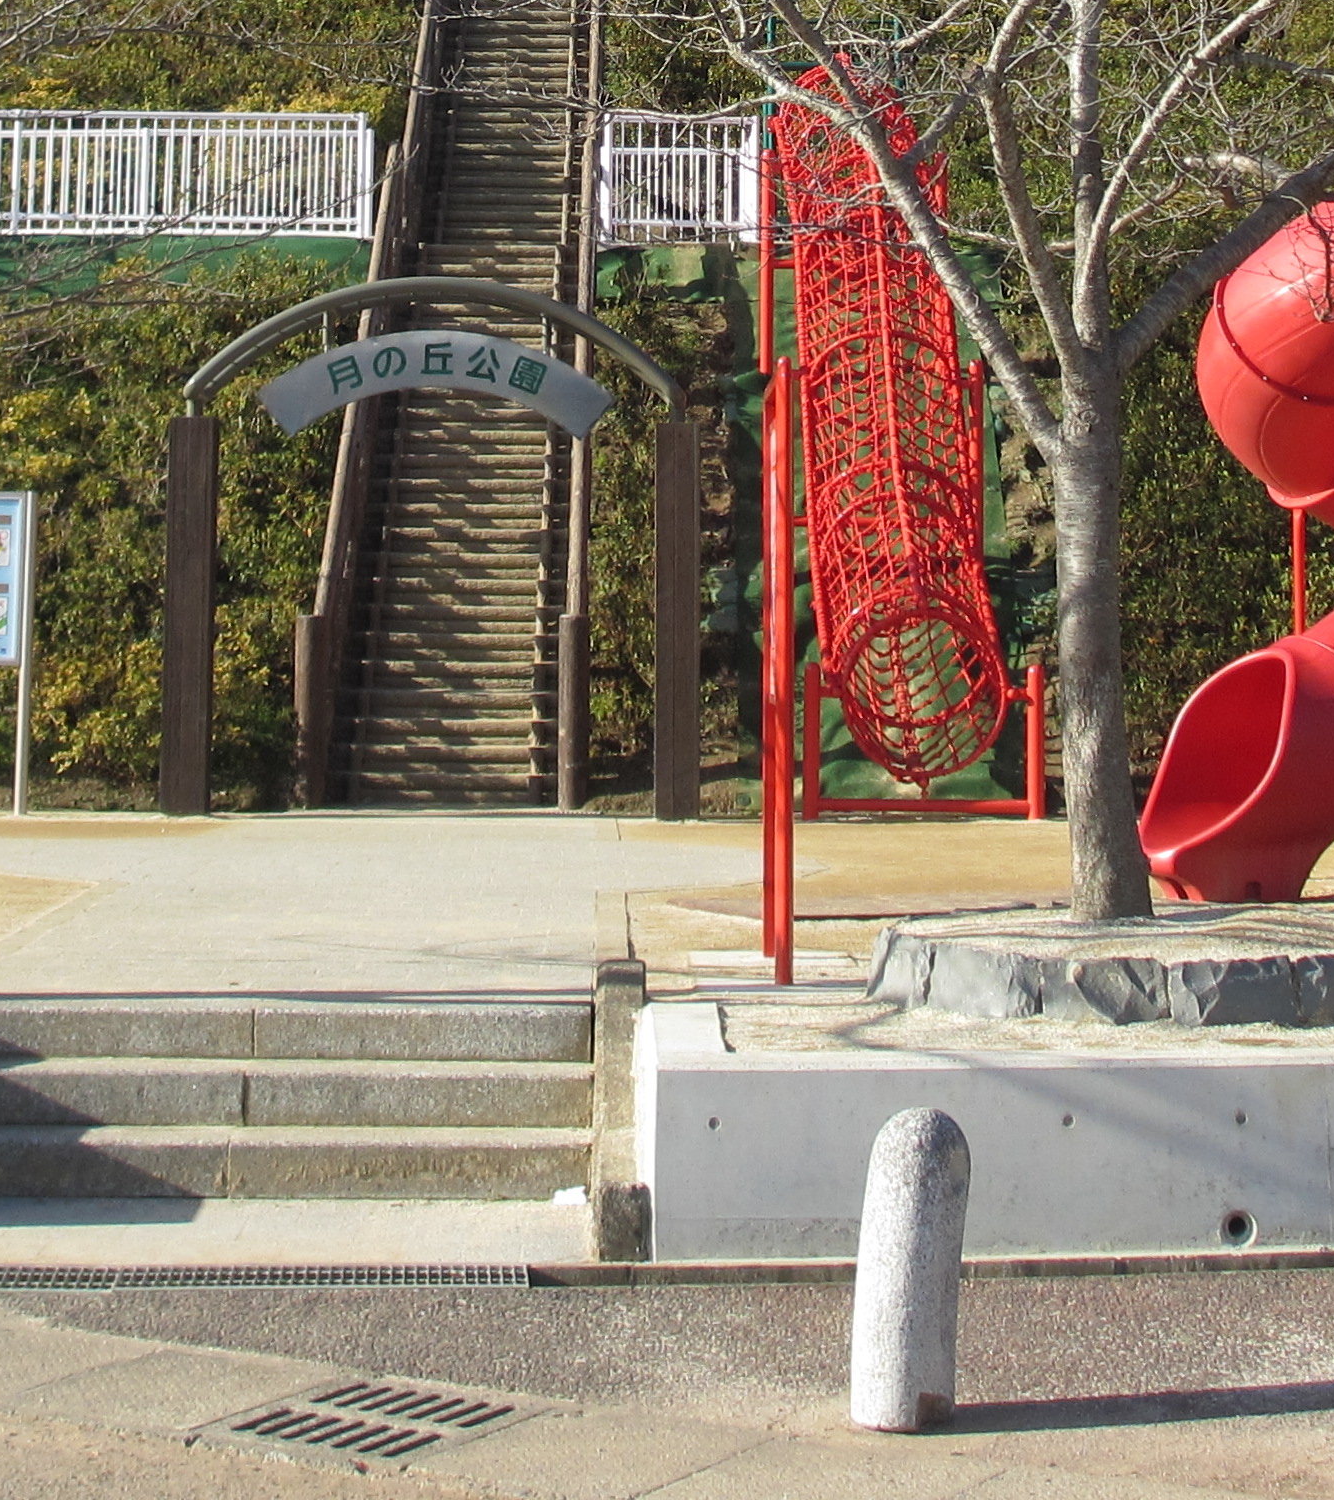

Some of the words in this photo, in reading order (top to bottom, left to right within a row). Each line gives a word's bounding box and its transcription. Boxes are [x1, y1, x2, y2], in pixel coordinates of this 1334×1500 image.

[327, 342, 547, 396] 月の丘公園
